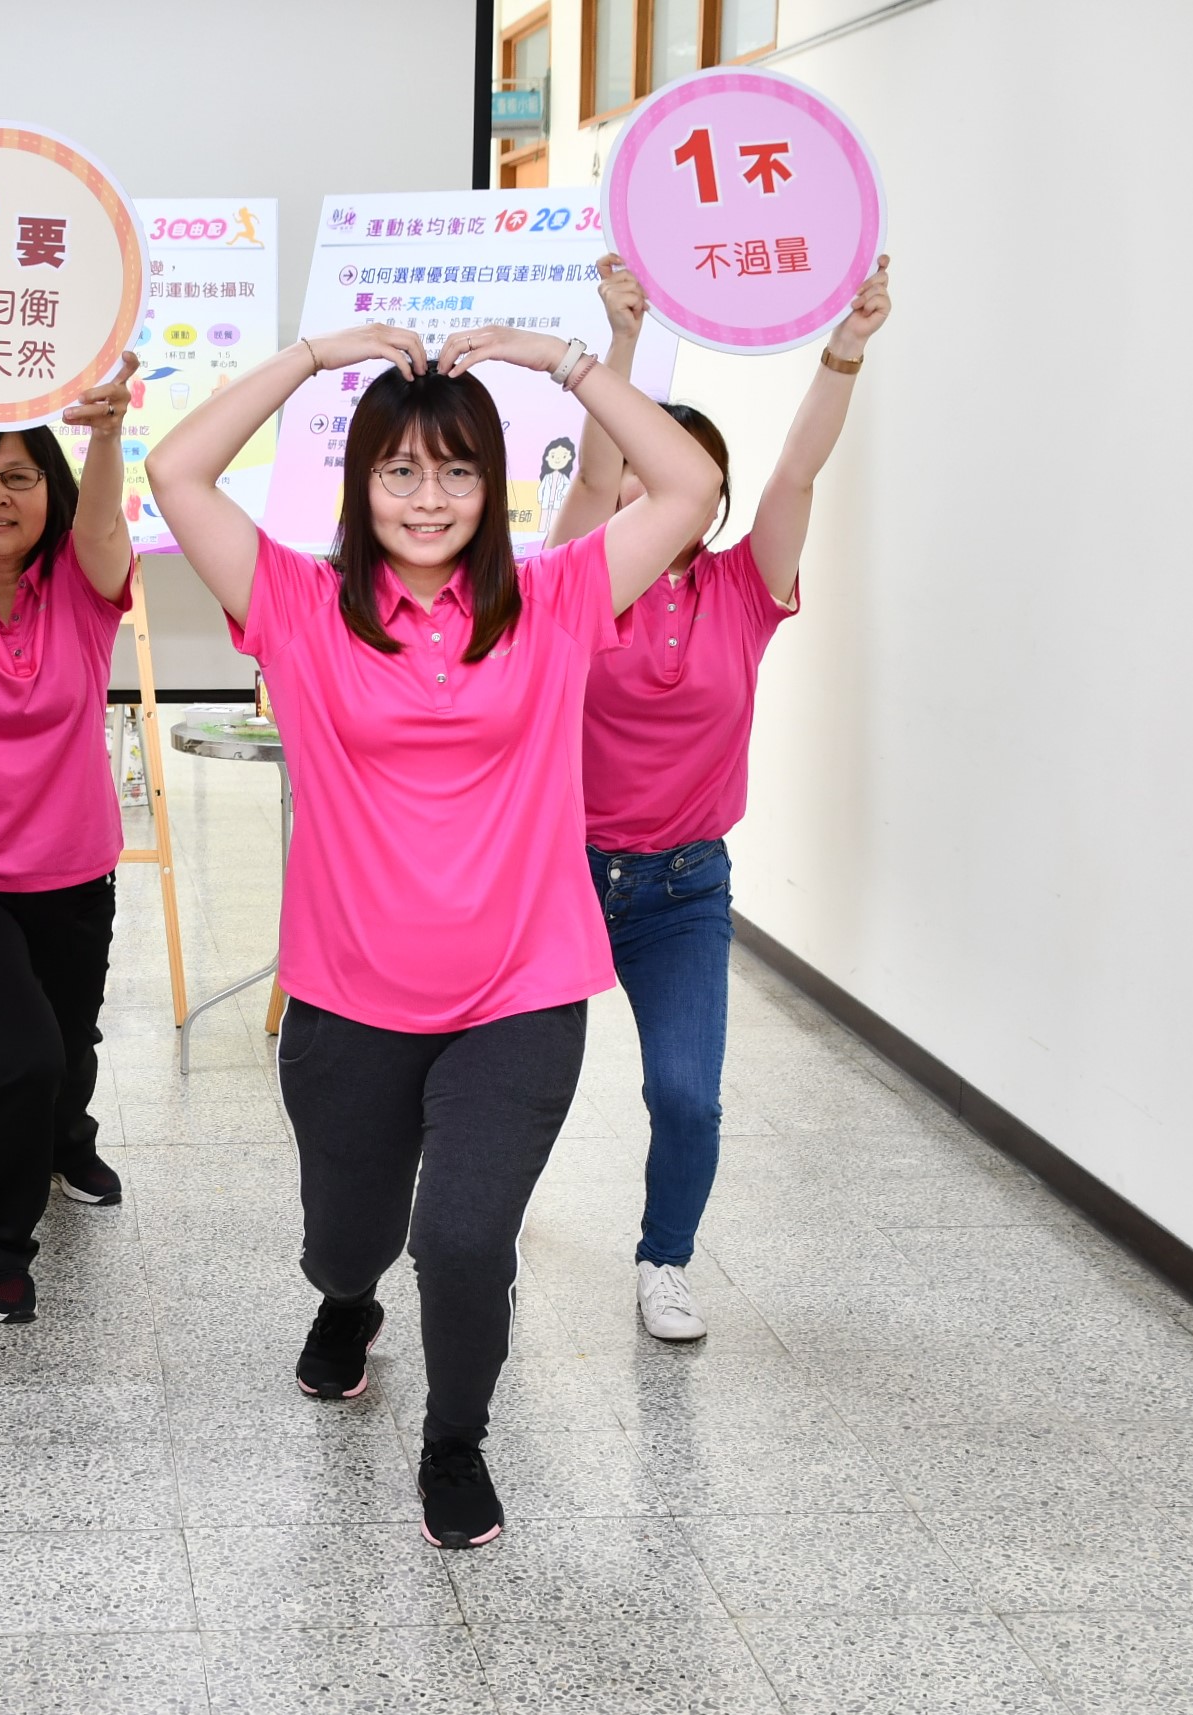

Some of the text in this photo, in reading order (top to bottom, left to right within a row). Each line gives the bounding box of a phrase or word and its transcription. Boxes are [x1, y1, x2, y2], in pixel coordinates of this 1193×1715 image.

[673, 127, 793, 204] 1 不
[16, 216, 68, 269] 要
[366, 216, 486, 238] 運動後均衡吃
[694, 236, 812, 281] 不過量
